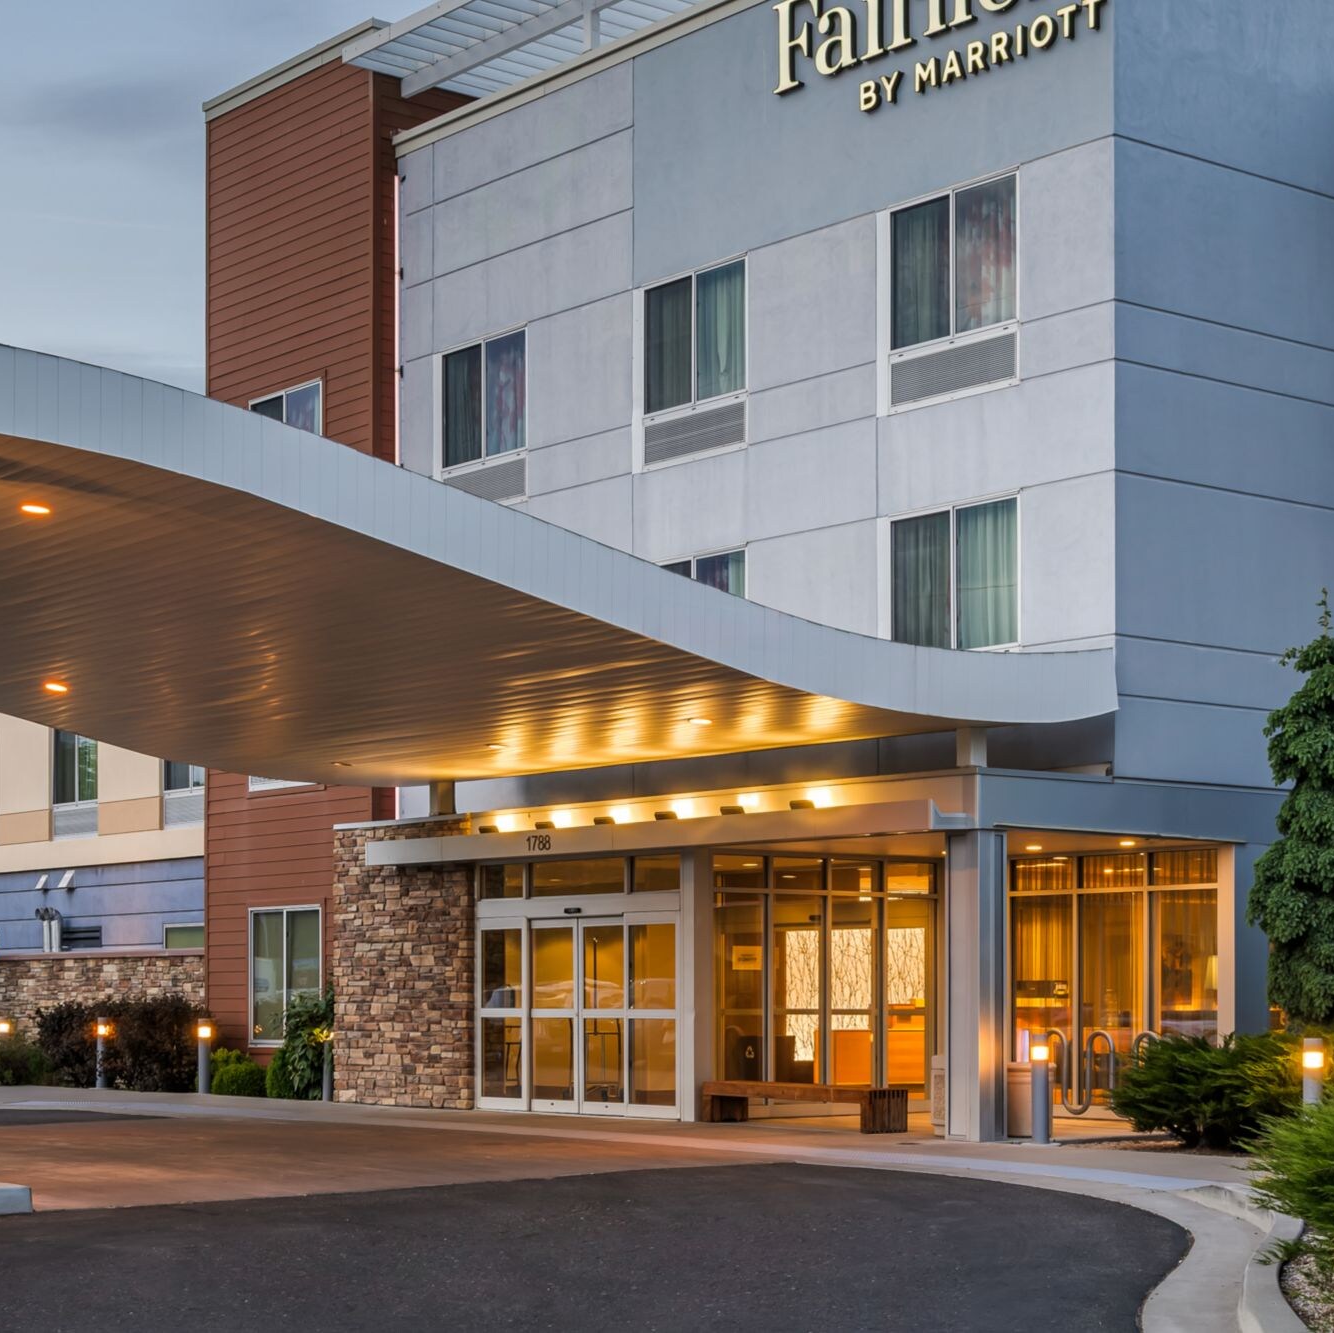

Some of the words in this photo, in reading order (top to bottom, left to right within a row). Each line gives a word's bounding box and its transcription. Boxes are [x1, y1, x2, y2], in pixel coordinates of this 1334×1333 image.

[859, 71, 903, 112] BY
[915, 0, 1107, 93] MARRIOTT
[526, 835, 551, 851] 1788
